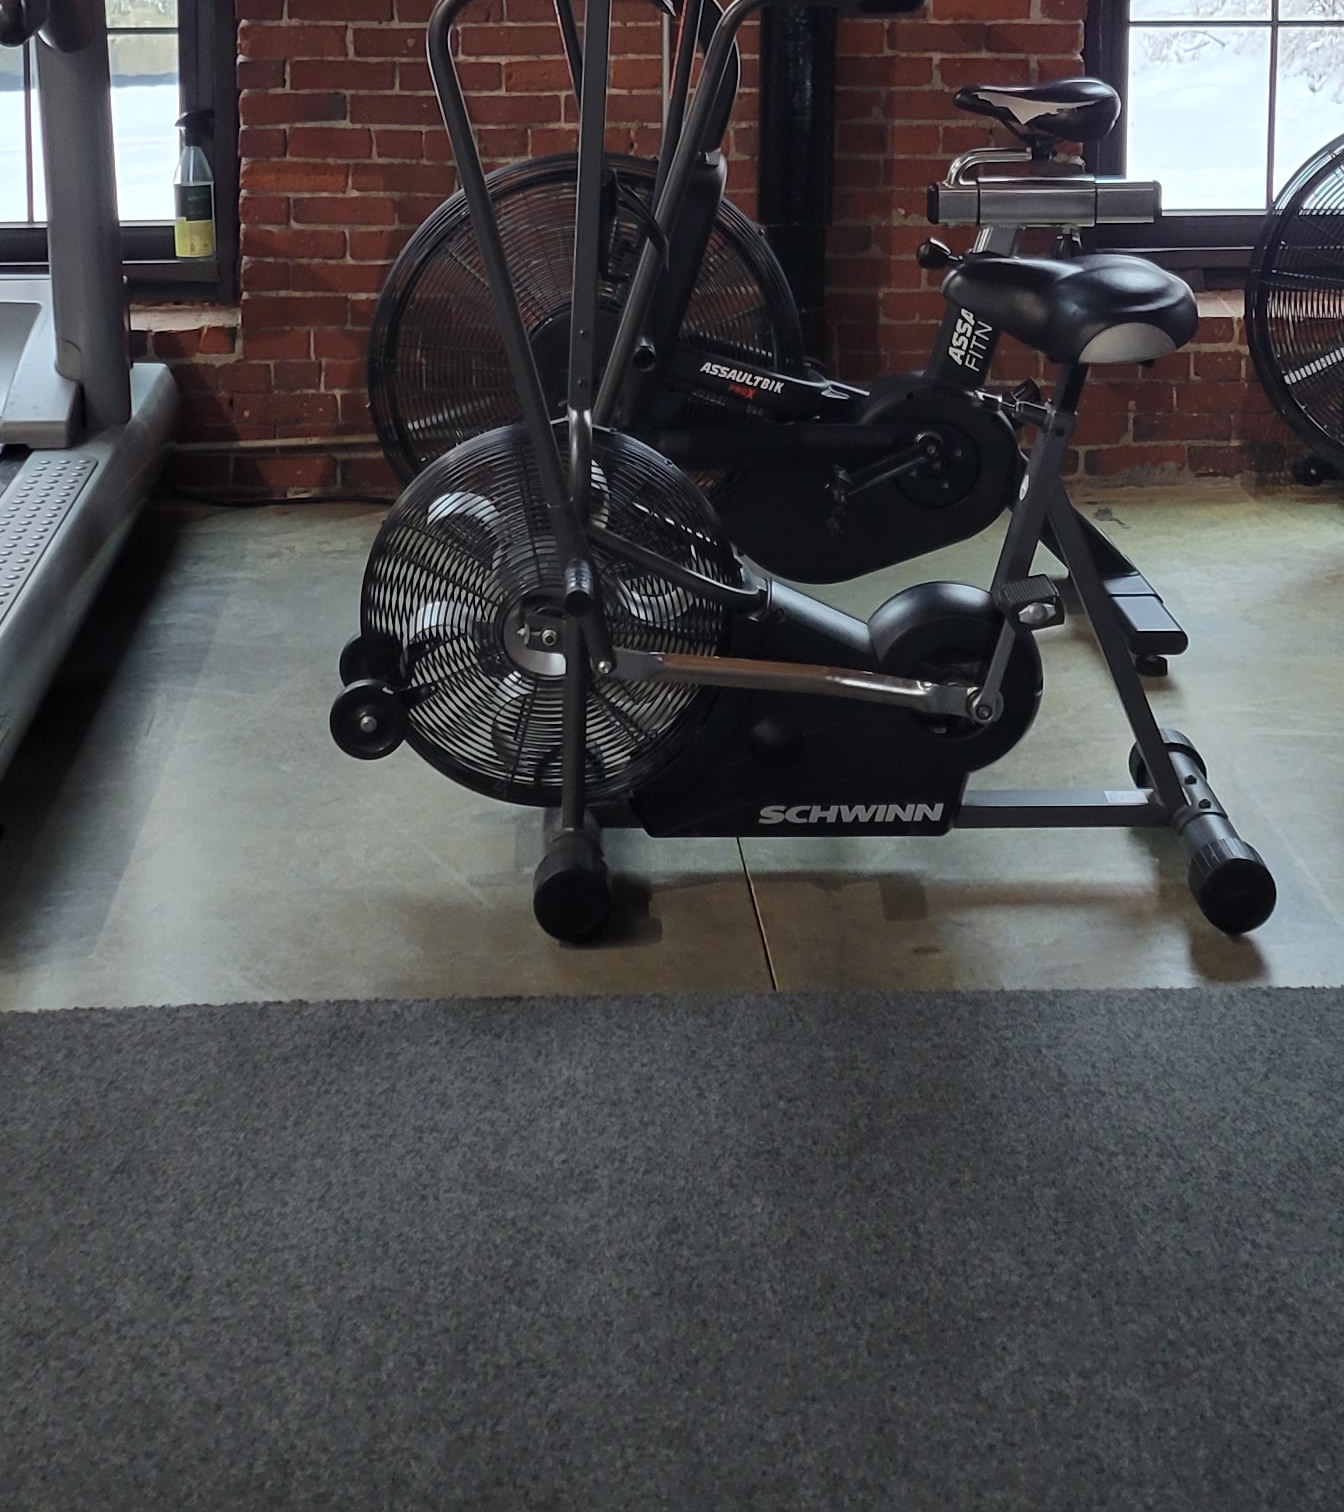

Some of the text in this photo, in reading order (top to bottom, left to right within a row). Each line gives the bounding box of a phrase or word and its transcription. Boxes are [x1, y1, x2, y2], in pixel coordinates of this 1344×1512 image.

[948, 308, 976, 366] ASSA
[964, 320, 993, 372] FITN
[758, 803, 944, 824] SCHWINN
